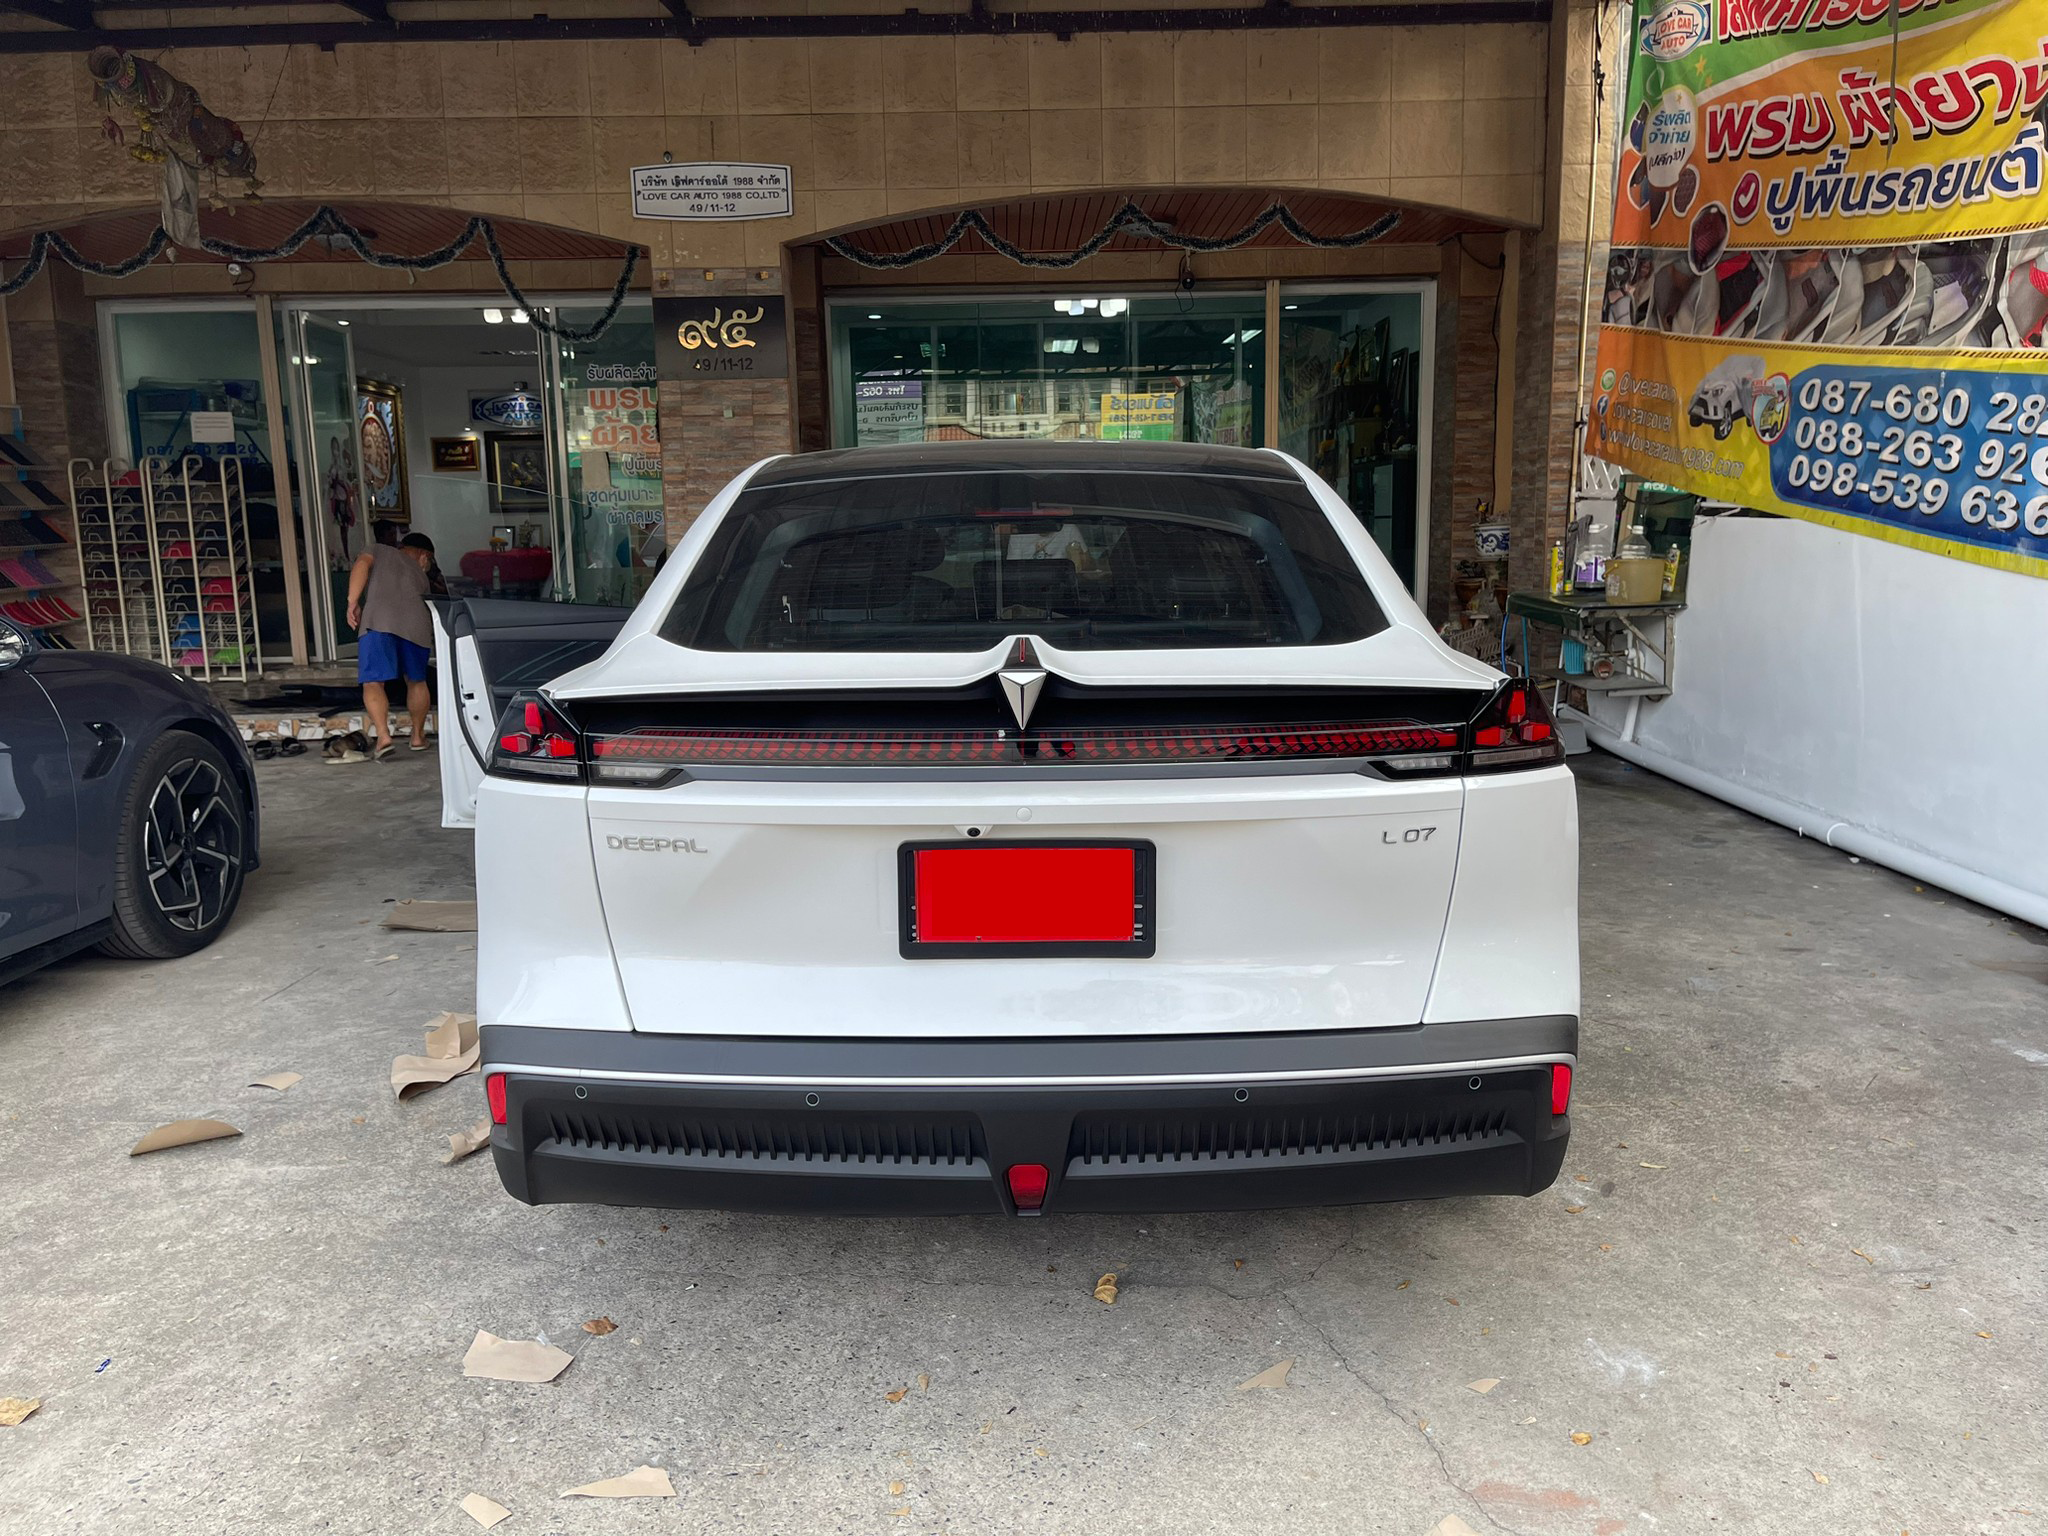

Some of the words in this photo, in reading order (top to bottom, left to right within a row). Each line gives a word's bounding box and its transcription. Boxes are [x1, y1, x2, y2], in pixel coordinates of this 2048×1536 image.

[1677, 15, 1692, 30] CAR
[1660, 33, 1686, 50] AUTO
[1707, 93, 1834, 157] พรม
[641, 175, 667, 187] บริษัท
[733, 177, 754, 186] 1988
[757, 174, 781, 186] จำกัด
[1765, 126, 2043, 232] ปูพื้นรถยนต์
[643, 193, 667, 201] LOVE
[670, 192, 690, 200] CAR
[693, 192, 719, 200] AUTO
[722, 191, 742, 200] 1988
[495, 402, 525, 412] LOVE
[1799, 378, 1970, 428] 087-680
[1794, 416, 1964, 473] 088-263
[1788, 454, 1950, 516] 098-539
[605, 834, 708, 854] DEEPAL
